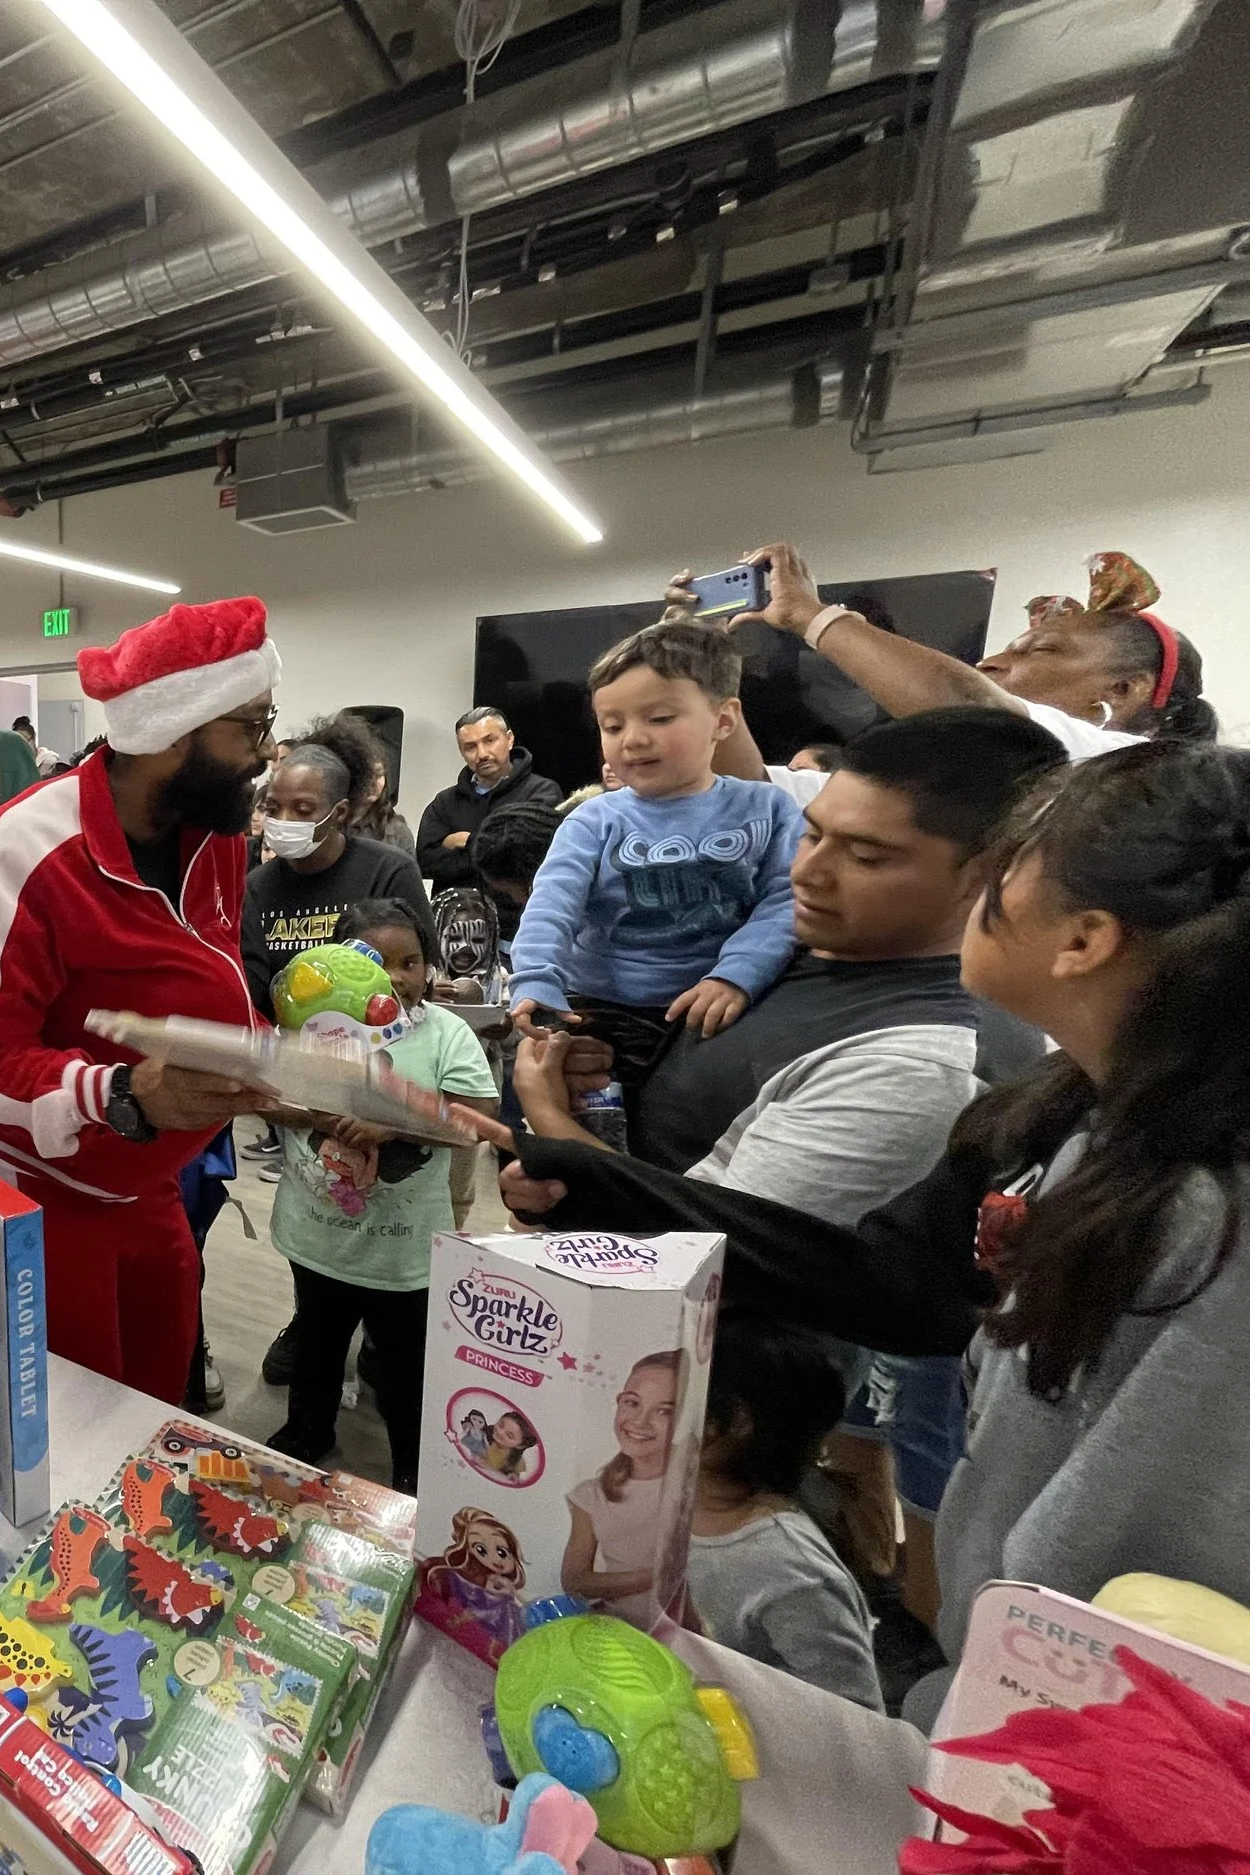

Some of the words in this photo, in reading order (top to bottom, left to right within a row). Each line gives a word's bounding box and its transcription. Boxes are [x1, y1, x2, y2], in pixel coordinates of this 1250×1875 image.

[44, 609, 70, 637] EXIT
[261, 910, 284, 919] LOS
[295, 902, 348, 917] ANGELE
[266, 939, 325, 951] ASKETBAL
[309, 1205, 324, 1224] he
[326, 1216, 362, 1233] ocean
[366, 1223, 375, 1237] is
[551, 1235, 620, 1253] Girlz
[555, 1243, 659, 1269] Sparkle
[17, 1268, 34, 1339] COLOR
[449, 1279, 559, 1332] Sparkle
[483, 1282, 516, 1300] ZURU
[474, 1314, 549, 1355] Girlz
[18, 1342, 37, 1419] TABLET
[465, 1349, 535, 1386] PRINCESS
[1002, 1626, 1119, 1700] CUT
[999, 1675, 1031, 1698] My
[13, 1749, 62, 1797] Control
[170, 1743, 220, 1789] ZZLE
[141, 1755, 218, 1818] UNKY
